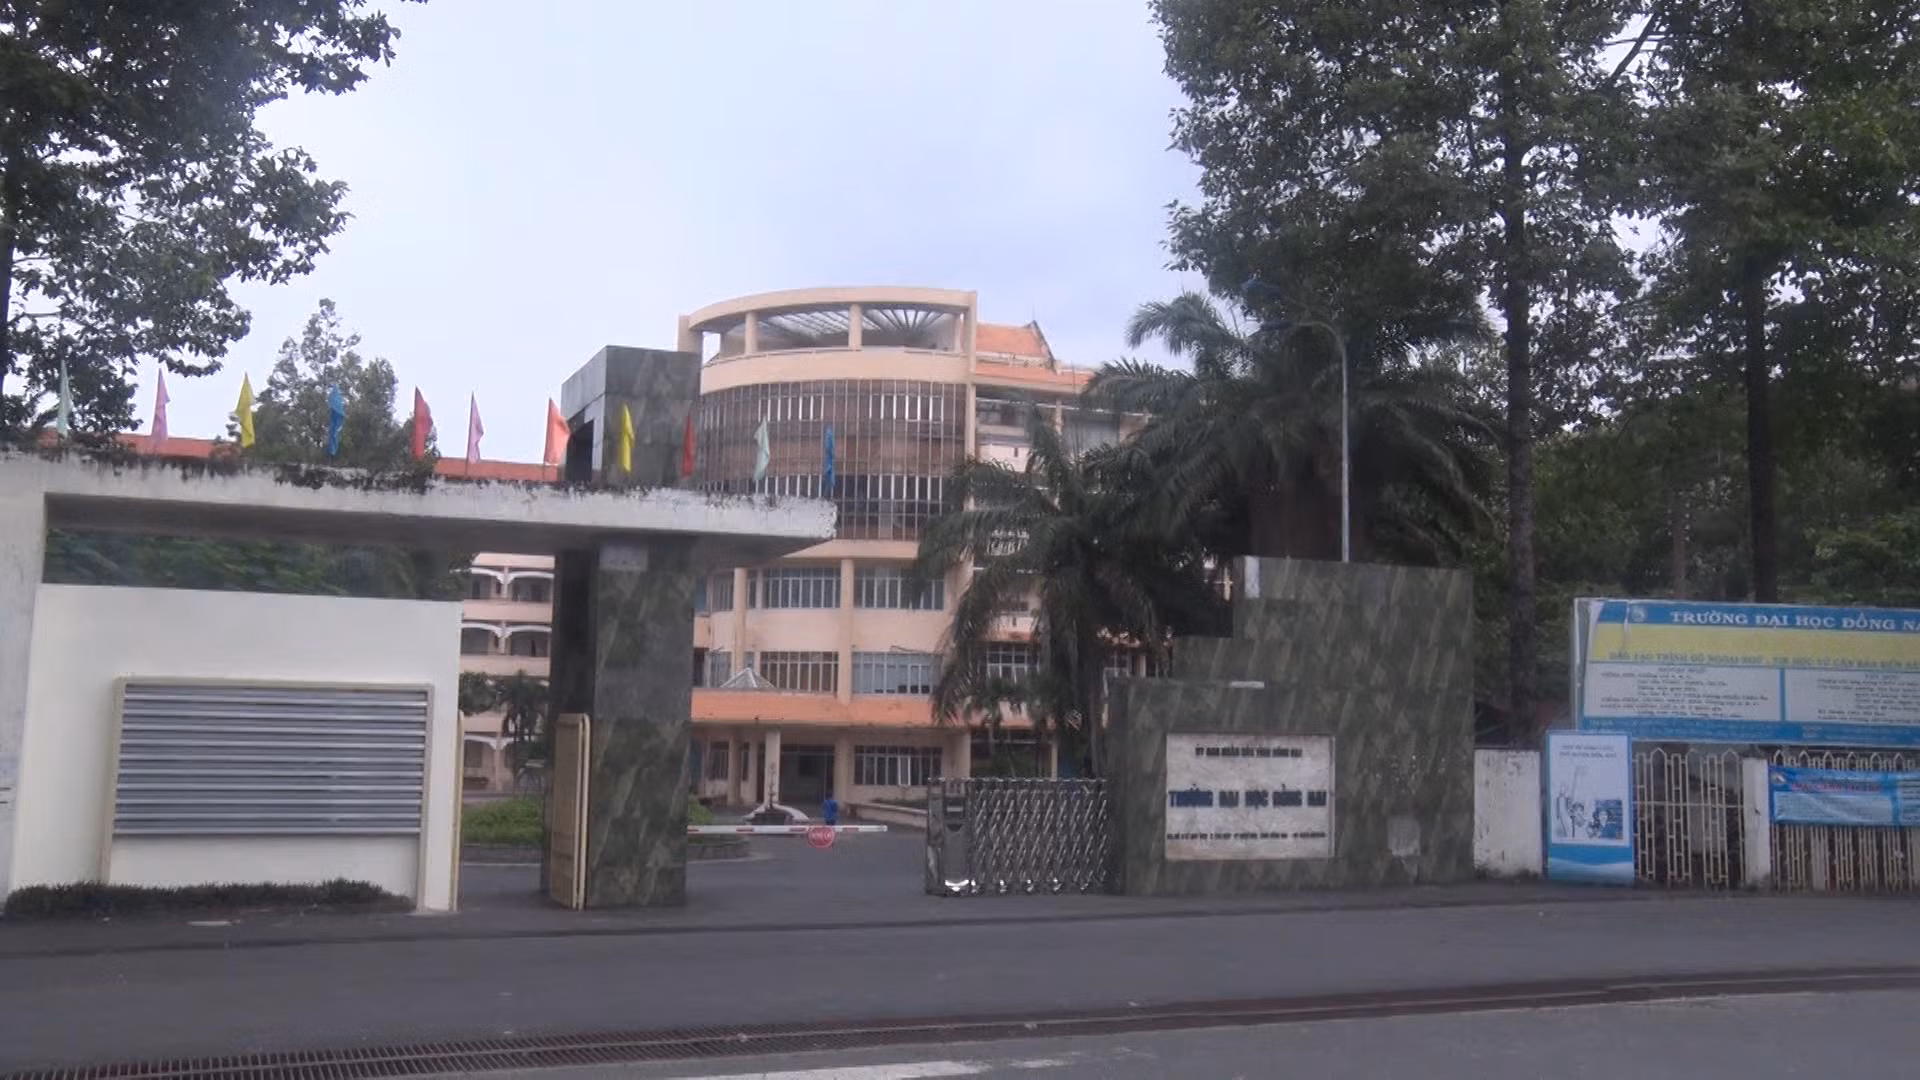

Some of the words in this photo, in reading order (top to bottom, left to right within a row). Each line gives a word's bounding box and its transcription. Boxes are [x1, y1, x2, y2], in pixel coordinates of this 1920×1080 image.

[1670, 609, 1748, 625] TRƯỜNG
[1755, 613, 1788, 629] ĐẠI
[1796, 615, 1836, 630] HỌC
